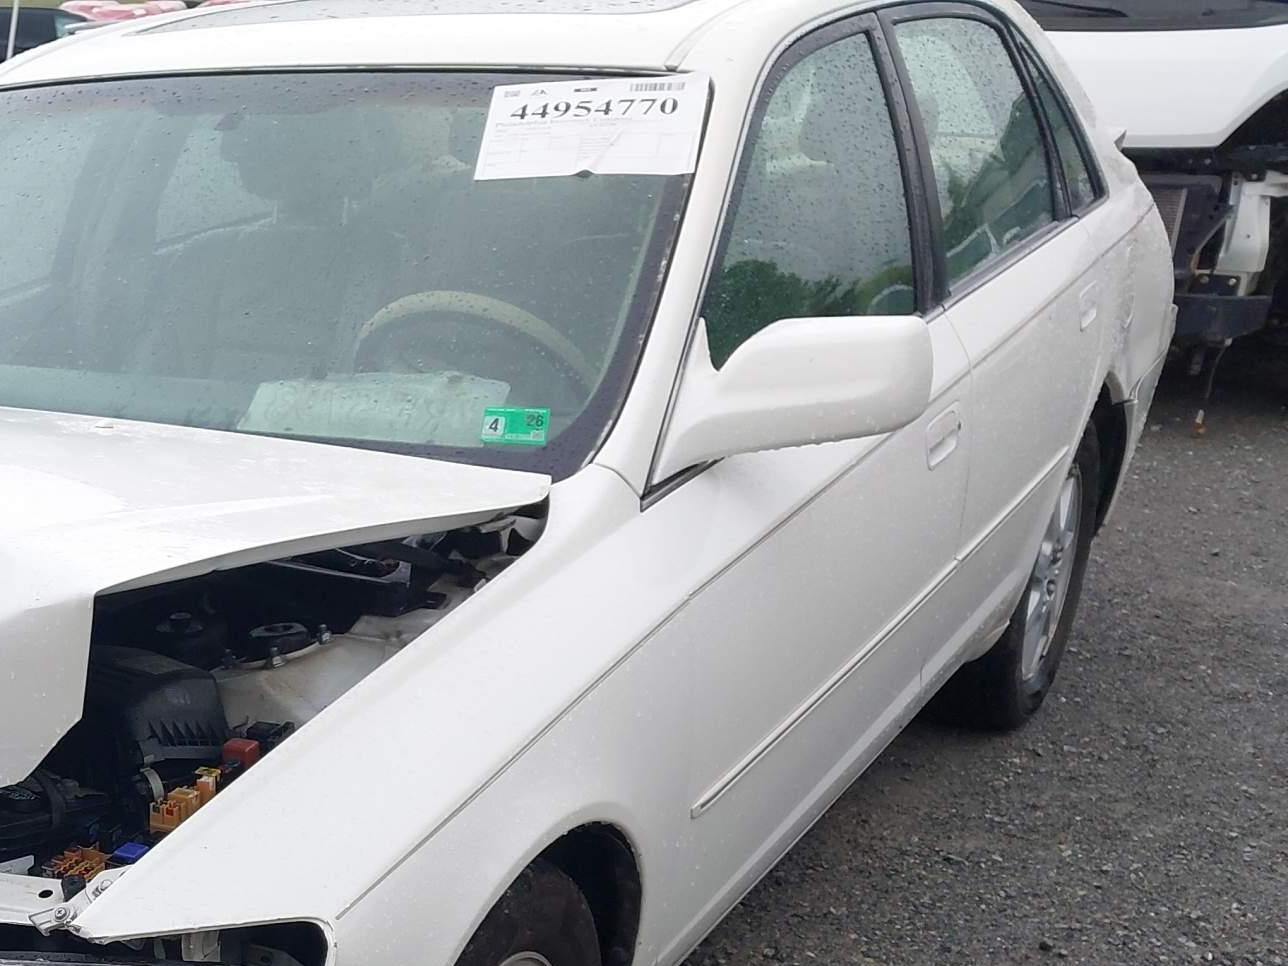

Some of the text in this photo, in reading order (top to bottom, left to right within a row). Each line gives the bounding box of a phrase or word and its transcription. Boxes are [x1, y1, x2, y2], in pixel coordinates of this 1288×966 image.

[509, 97, 679, 120] 44954770
[488, 414, 545, 432] 4 26
